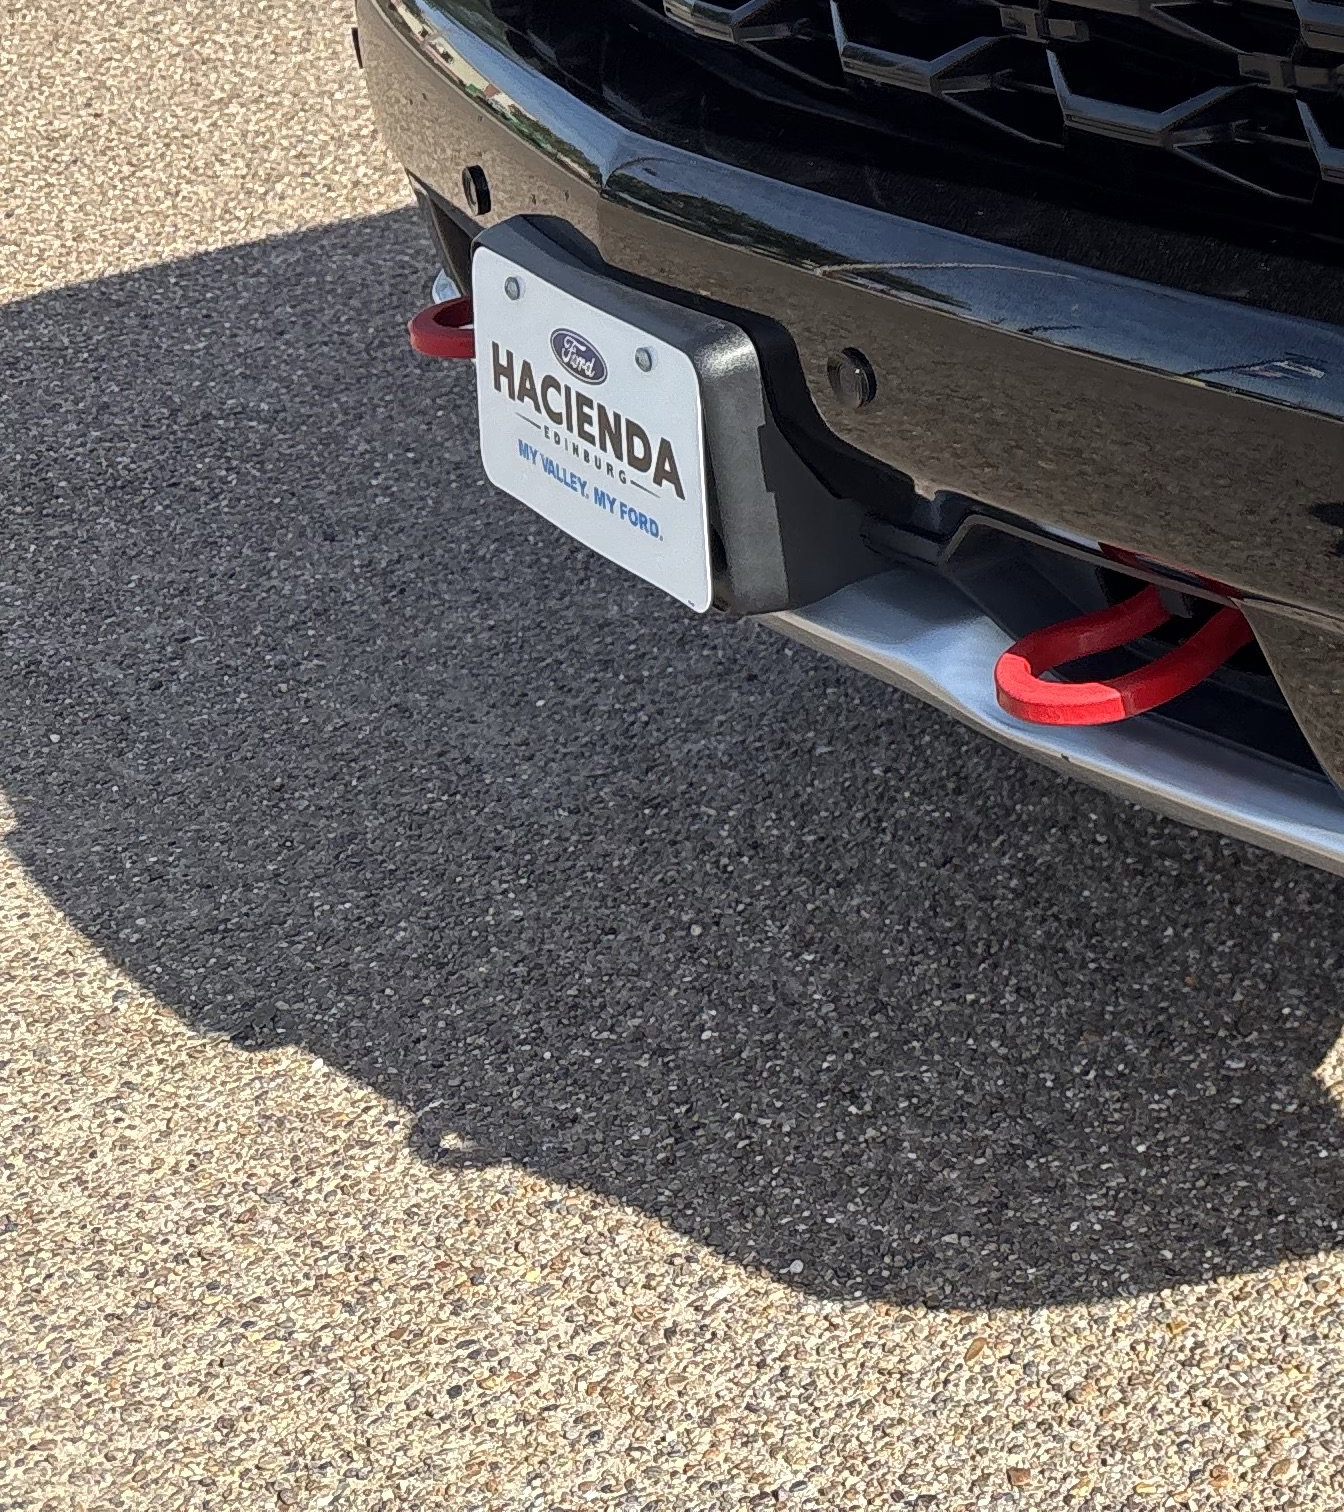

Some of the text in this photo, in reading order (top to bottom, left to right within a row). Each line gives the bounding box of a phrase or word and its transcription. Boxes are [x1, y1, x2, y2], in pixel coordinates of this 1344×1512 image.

[559, 334, 598, 379] Ford
[491, 341, 686, 500] HACIENDA
[543, 424, 627, 484] EDINBURG
[518, 439, 664, 541] MY VALLEY. MY FORD.
